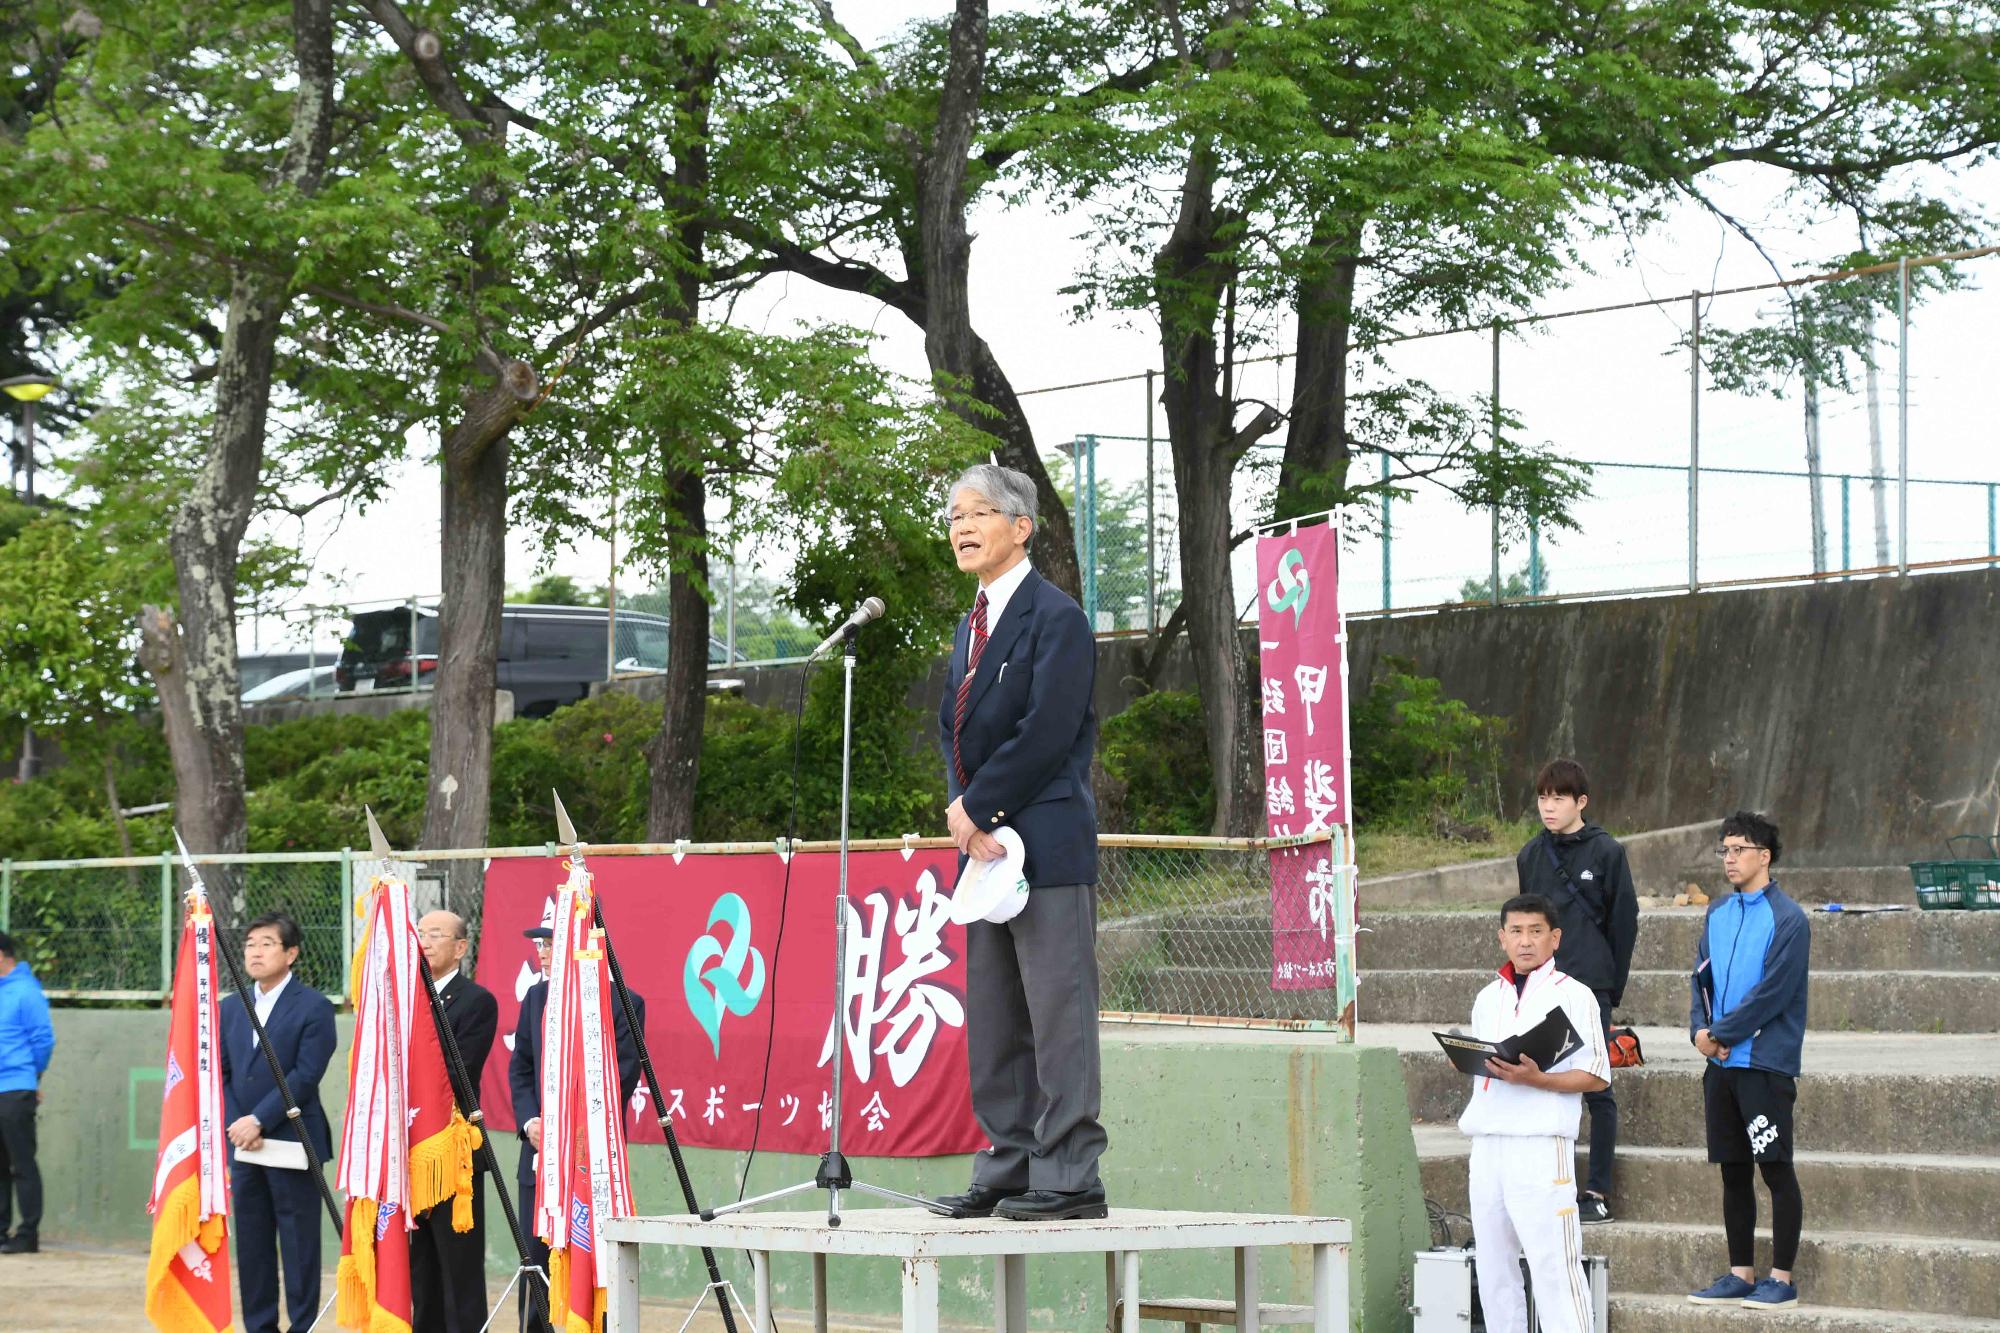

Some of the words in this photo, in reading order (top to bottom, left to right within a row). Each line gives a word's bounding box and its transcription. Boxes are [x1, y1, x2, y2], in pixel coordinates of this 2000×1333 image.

[197, 927, 210, 966] 優勝
[199, 978, 210, 1073] 平成十九年度
